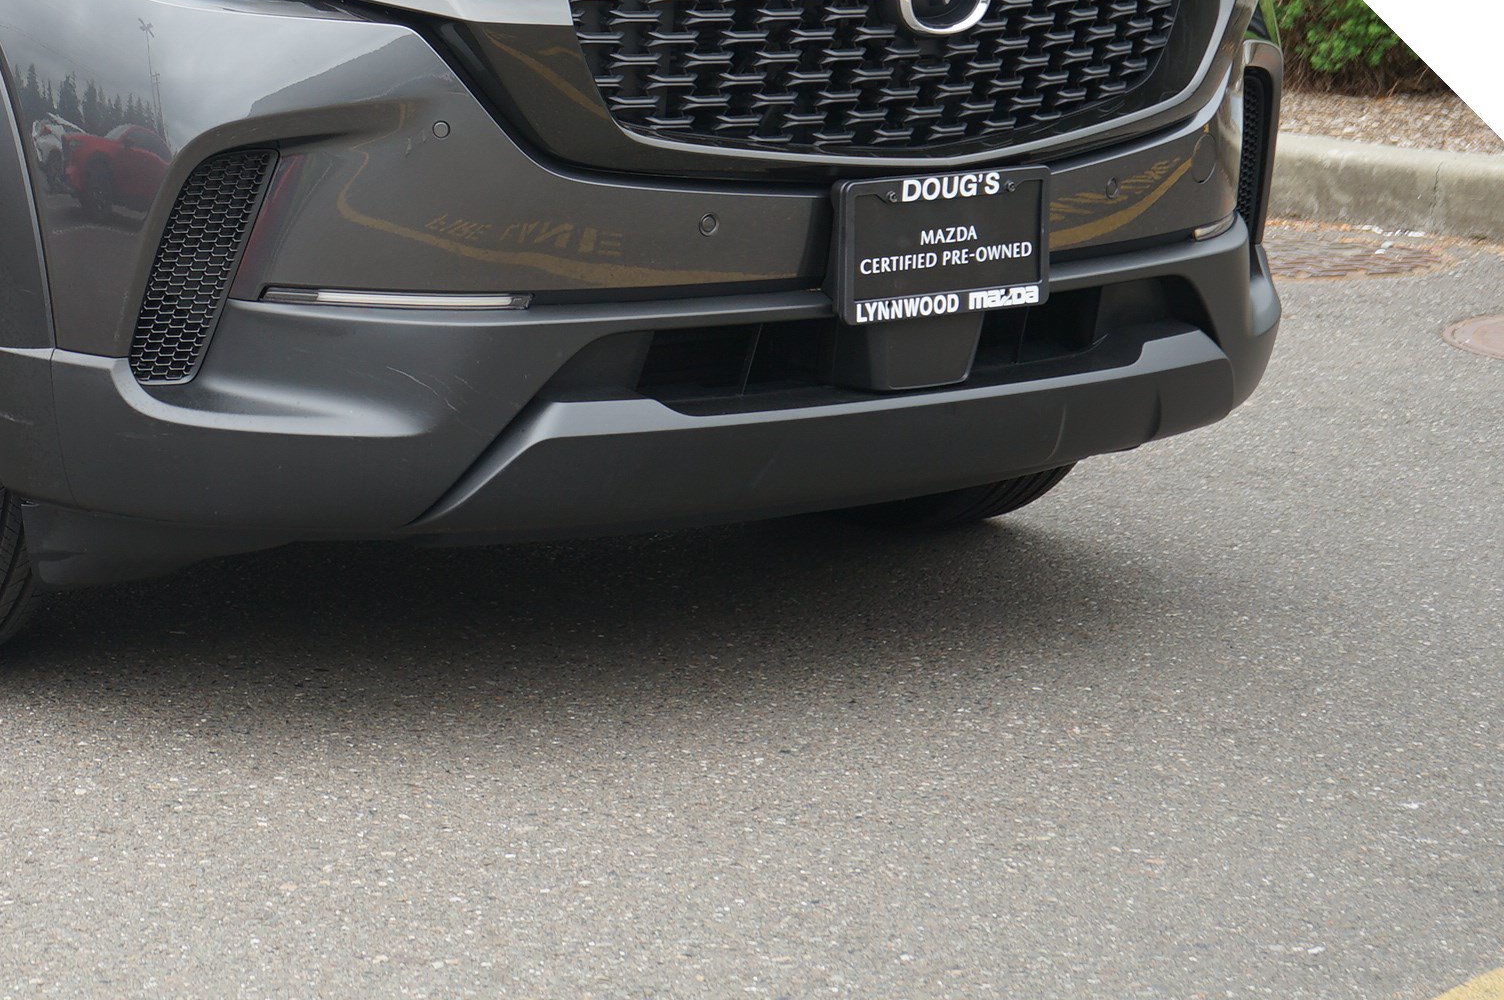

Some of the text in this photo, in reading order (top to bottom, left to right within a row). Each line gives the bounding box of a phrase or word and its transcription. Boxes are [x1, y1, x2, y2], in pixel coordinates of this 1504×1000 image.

[901, 171, 1001, 203] DOUG'S
[920, 225, 978, 246] MAZDA
[859, 241, 1033, 275] CERTIFIED PRE-OWNED
[856, 293, 960, 323] LYNNWOOD
